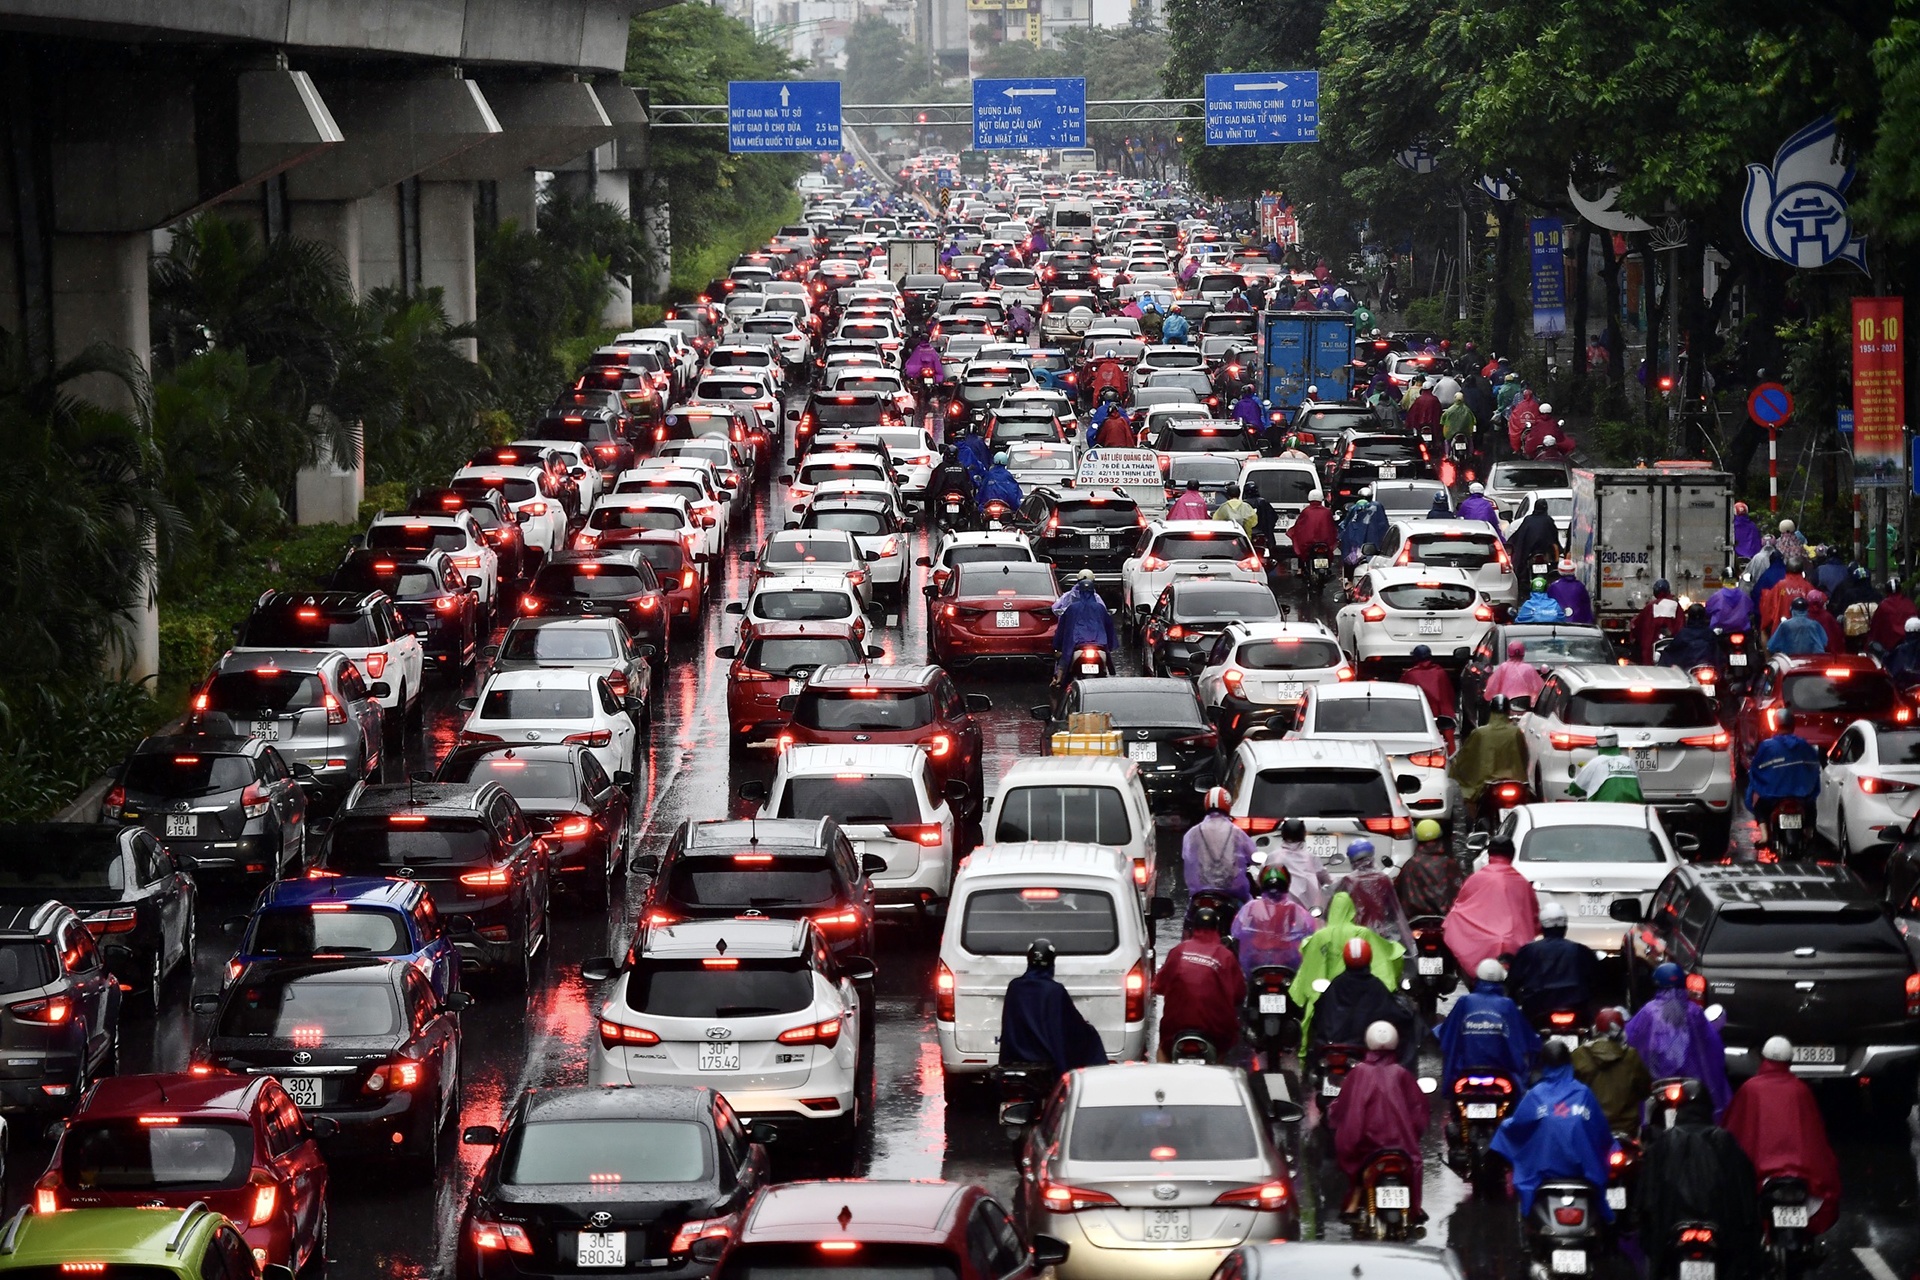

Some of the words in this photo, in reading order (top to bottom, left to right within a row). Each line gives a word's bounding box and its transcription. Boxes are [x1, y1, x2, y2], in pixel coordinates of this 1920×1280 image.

[1304, 100, 1314, 108] km
[732, 107, 745, 118] NÚT
[747, 109, 762, 118] GIAO
[1069, 106, 1079, 115] km
[979, 119, 992, 129] NÚT
[1063, 120, 1067, 128] 5
[1069, 120, 1079, 128] km
[1210, 114, 1222, 125] NÚT
[1225, 116, 1239, 124] GIAO
[1304, 114, 1314, 122] km
[732, 120, 745, 132] NÚT
[747, 123, 762, 132] GIAO
[828, 123, 838, 132] km
[1061, 134, 1067, 142] 11
[1069, 133, 1079, 142] km
[1244, 130, 1257, 138] TUY
[1304, 128, 1315, 136] km
[828, 136, 838, 146] km
[1860, 344, 1875, 353] 1954
[1881, 344, 1896, 352] 2021
[1841, 414, 1854, 422] NG
[1602, 552, 1648, 564] 29C-656.62
[257, 722, 272, 730] 30E
[1635, 750, 1650, 759] 30E
[174, 816, 190, 825] 30A
[708, 1042, 728, 1055] 30F
[702, 1056, 738, 1068] 175.42
[290, 1079, 314, 1092] 30X
[1155, 1210, 1179, 1224] 30G
[1146, 1225, 1188, 1240] 457.19
[590, 1234, 614, 1248] 30E
[580, 1250, 623, 1264] 580.34
